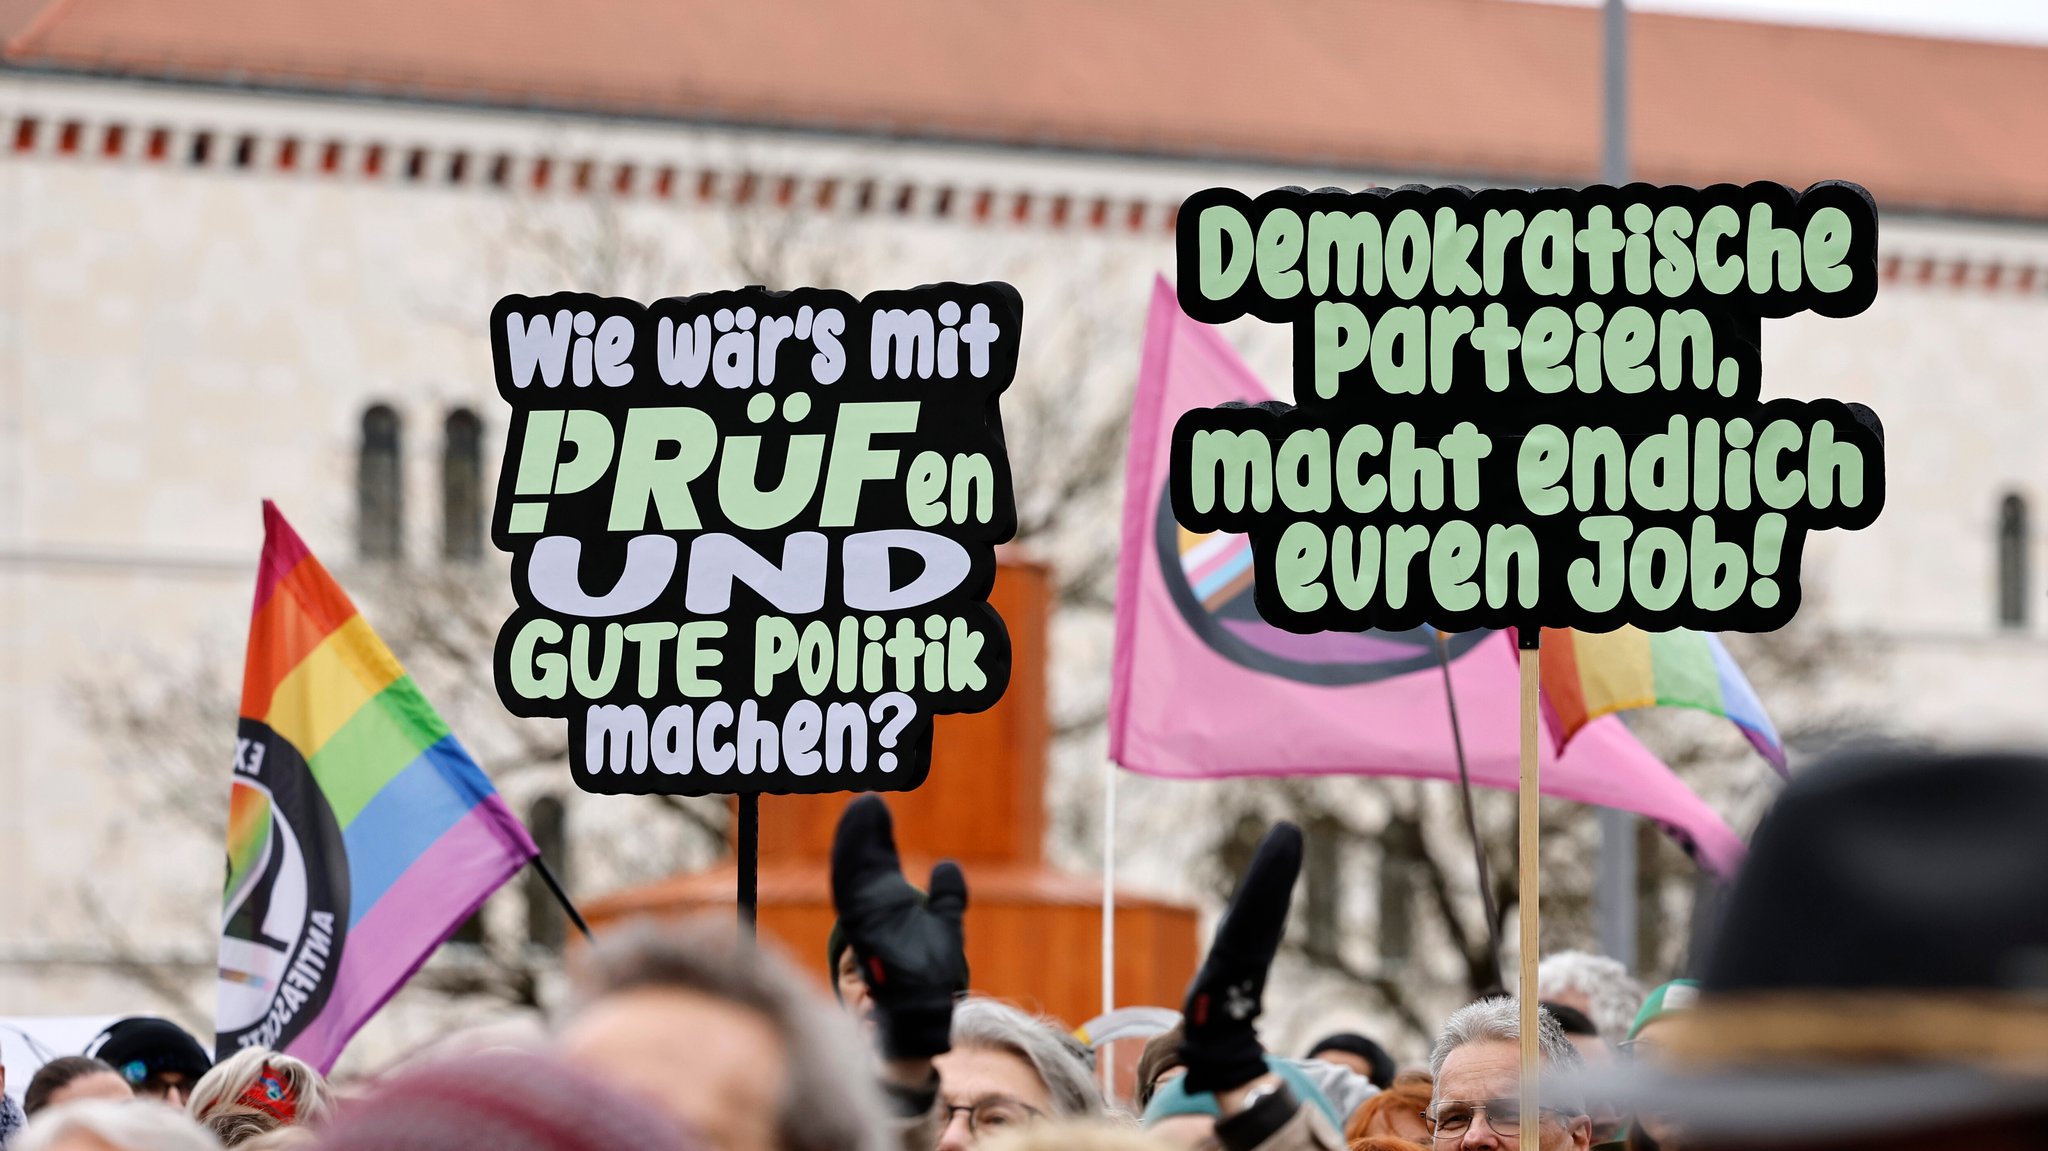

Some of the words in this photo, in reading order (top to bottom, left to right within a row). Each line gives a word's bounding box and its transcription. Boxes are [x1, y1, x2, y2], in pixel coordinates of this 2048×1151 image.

[1199, 202, 1853, 300] Demokratische
[507, 309, 634, 388] Wie
[657, 305, 846, 389] wär's
[871, 301, 1000, 380] mit
[1315, 301, 1739, 399] Parteien,
[1192, 421, 1492, 514] macht
[1517, 413, 1863, 516] endlich
[528, 529, 971, 618] UND
[1276, 520, 1539, 612] euren
[1567, 512, 1787, 612] Job!
[510, 618, 728, 700] GUTE
[755, 614, 987, 698] Politik
[586, 691, 917, 775] machen?
